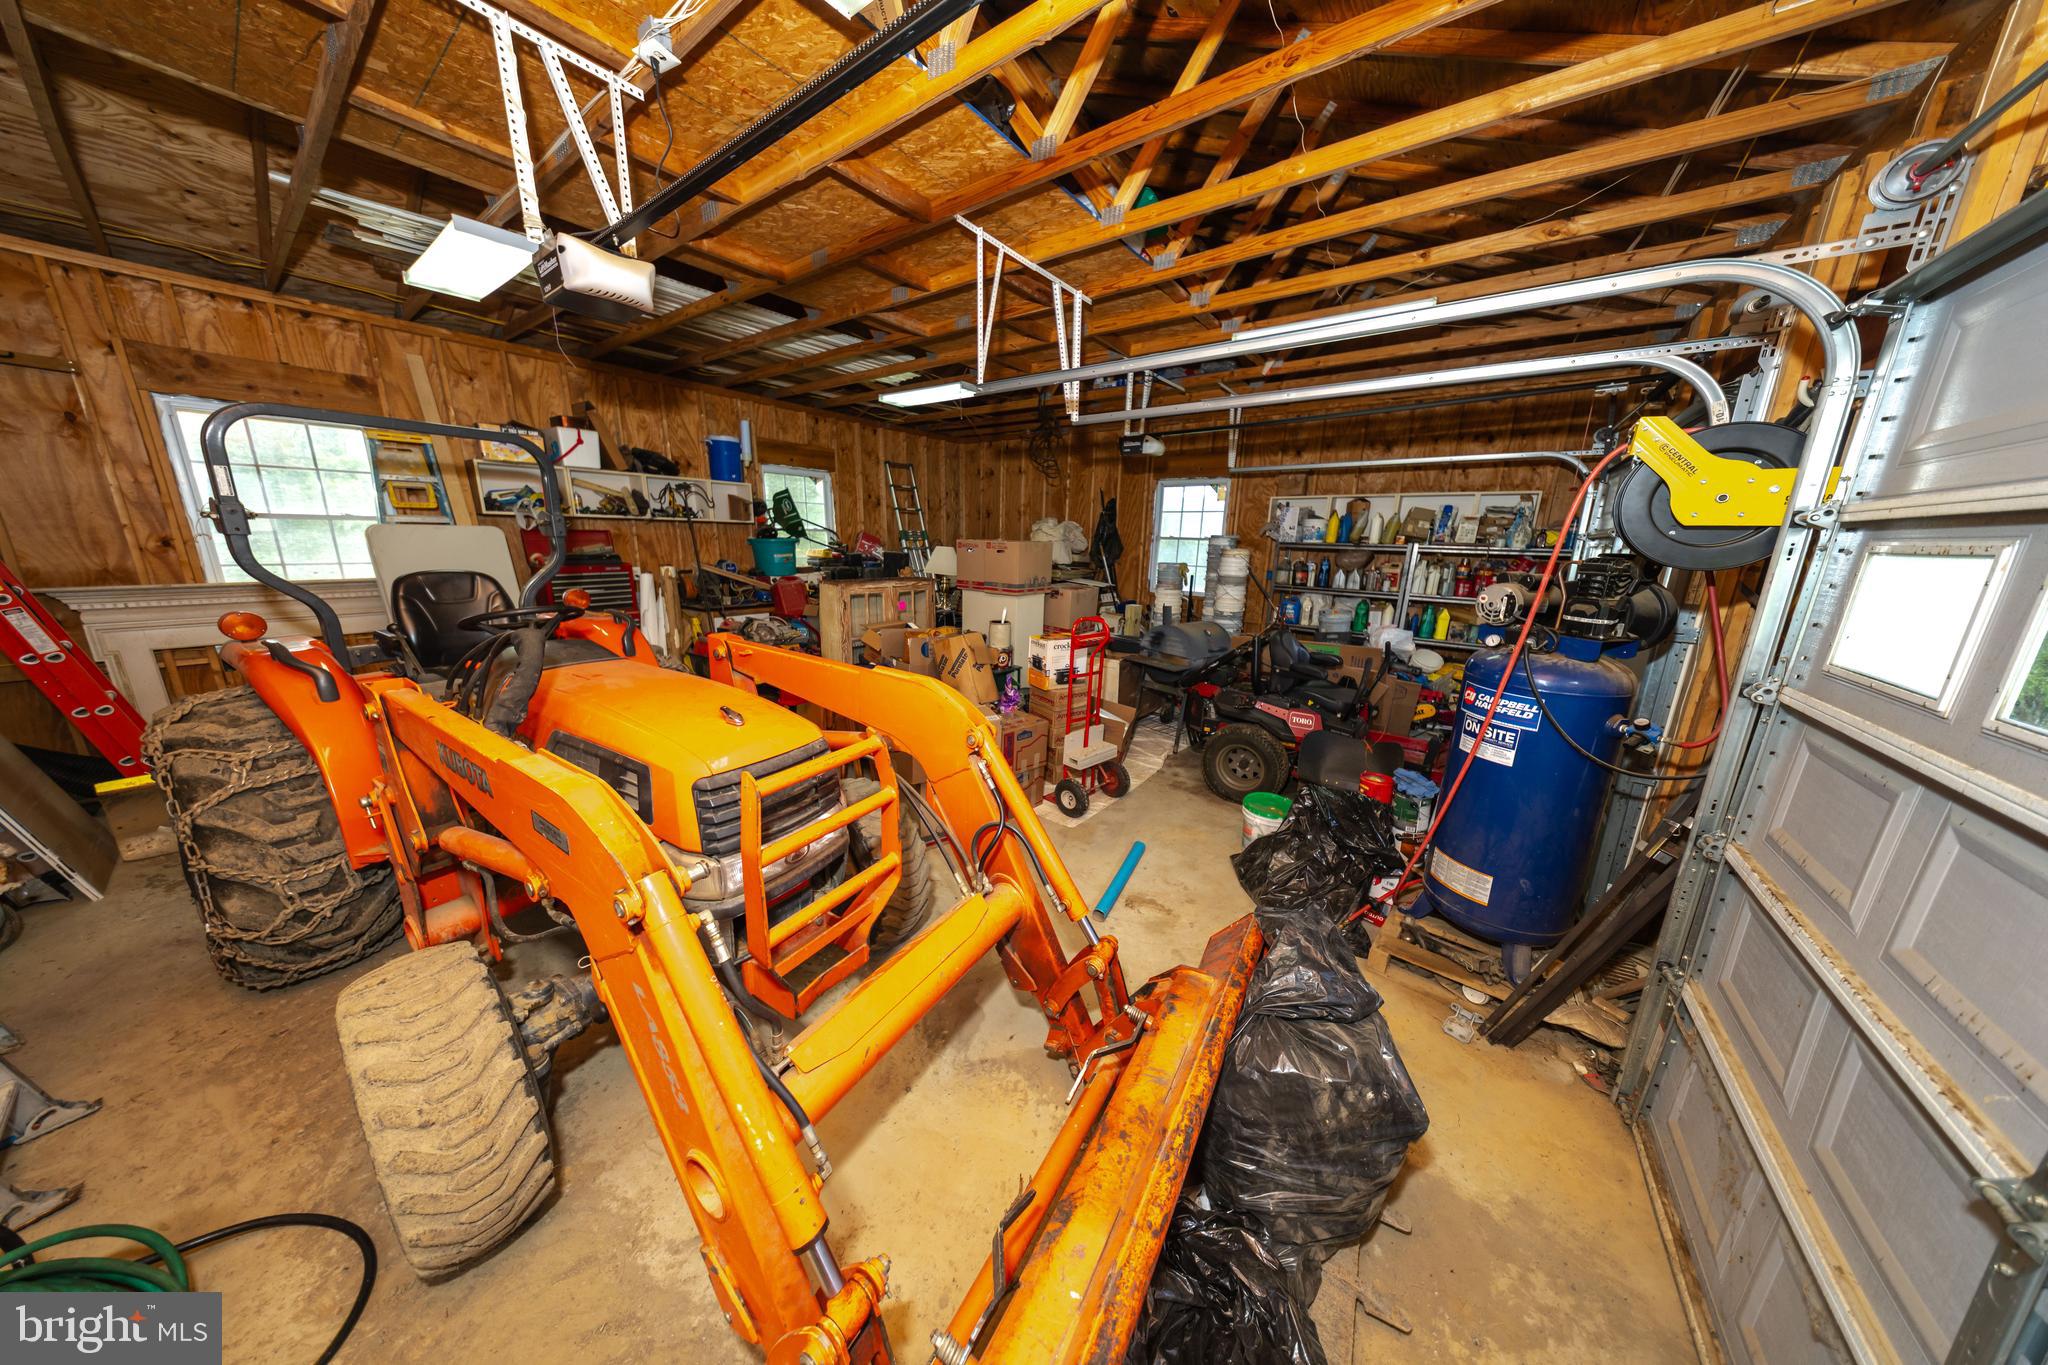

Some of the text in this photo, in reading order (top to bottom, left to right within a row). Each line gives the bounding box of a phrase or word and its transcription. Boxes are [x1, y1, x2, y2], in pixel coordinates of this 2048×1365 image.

[1664, 450, 1694, 478] PNEUMATIC
[1668, 447, 1698, 475] CENTRAL
[1292, 716, 1312, 725] TORO
[1465, 719, 1480, 734] ON
[1485, 727, 1516, 743] SITE
[436, 740, 494, 800] KUBOTA
